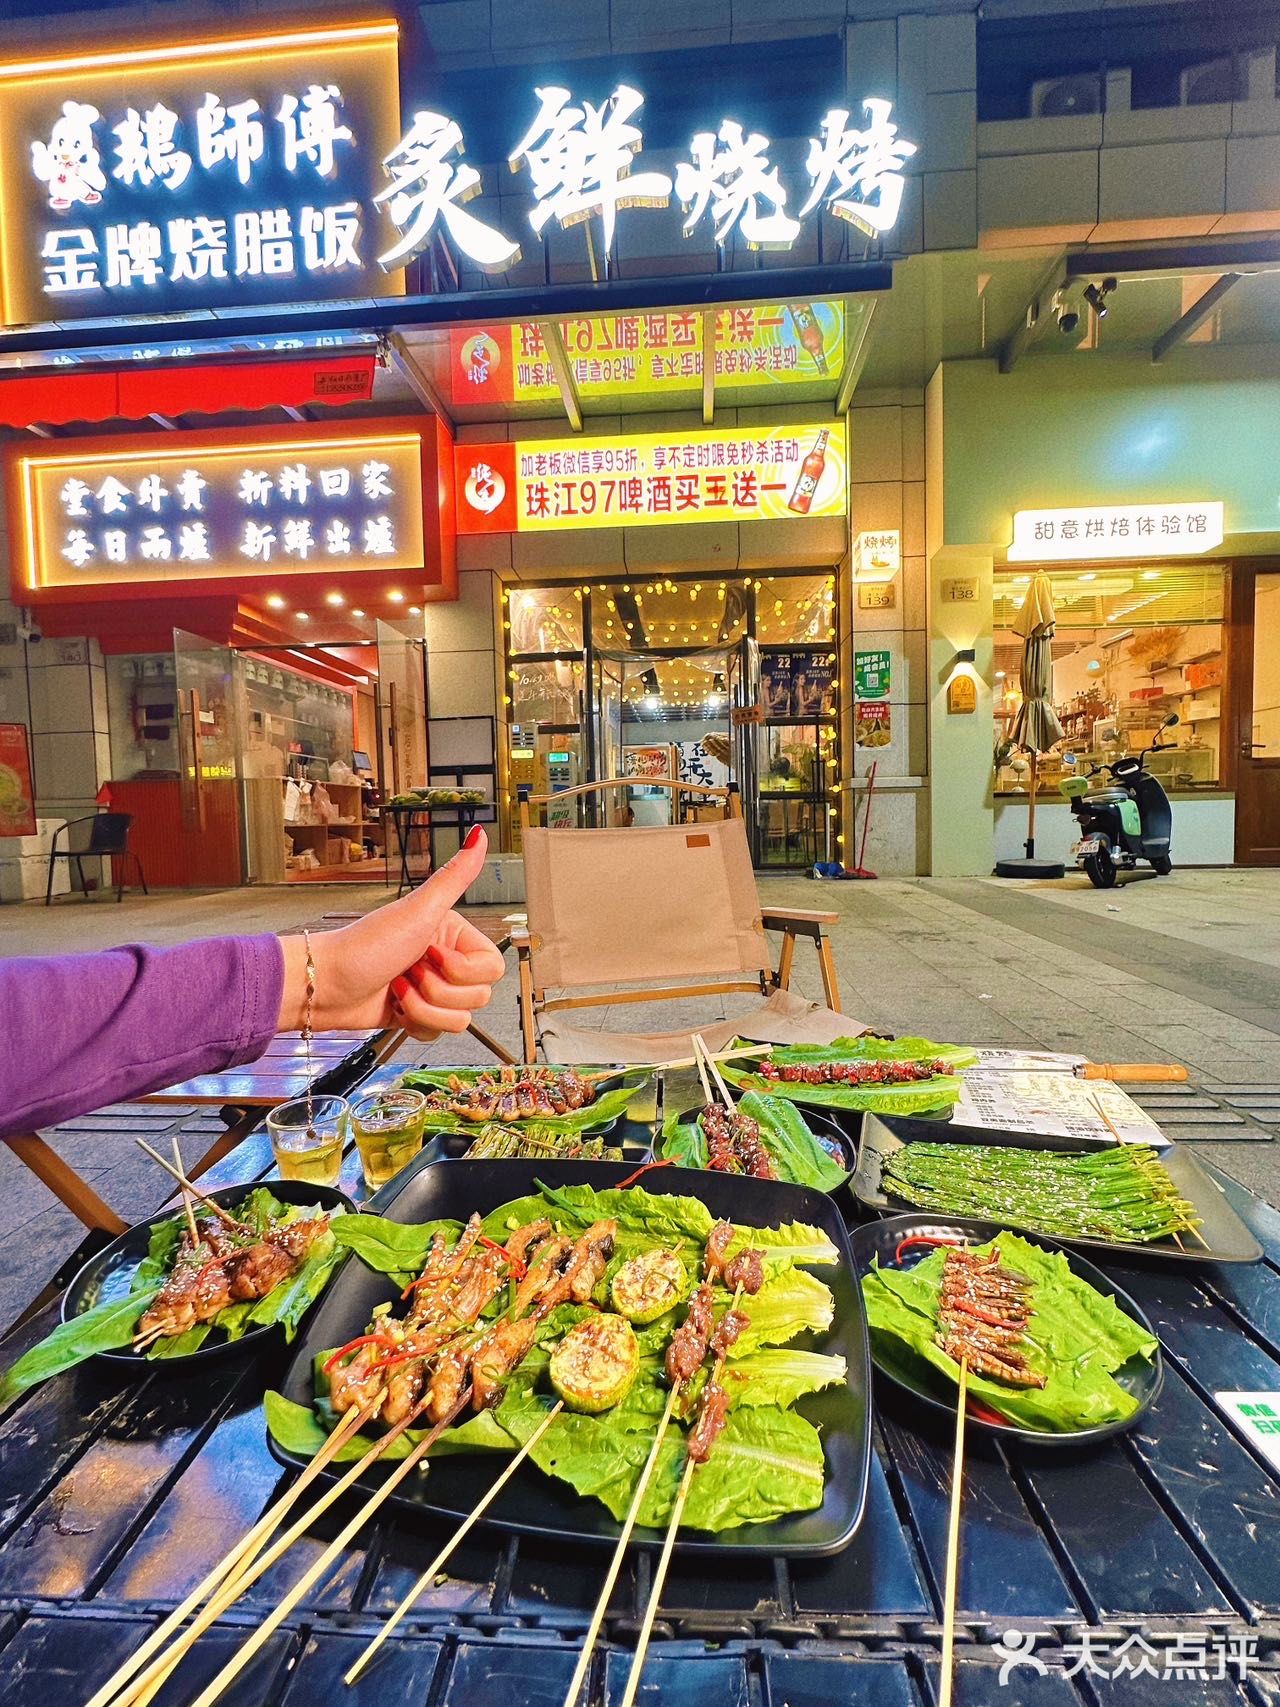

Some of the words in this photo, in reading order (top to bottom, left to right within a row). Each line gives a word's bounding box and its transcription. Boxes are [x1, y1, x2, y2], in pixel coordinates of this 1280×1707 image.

[41, 203, 361, 293] 金牌烧腊饭
[1034, 514, 1208, 540] 甜意烘焙体验馆
[867, 596, 890, 606] 139
[949, 590, 974, 600] 138
